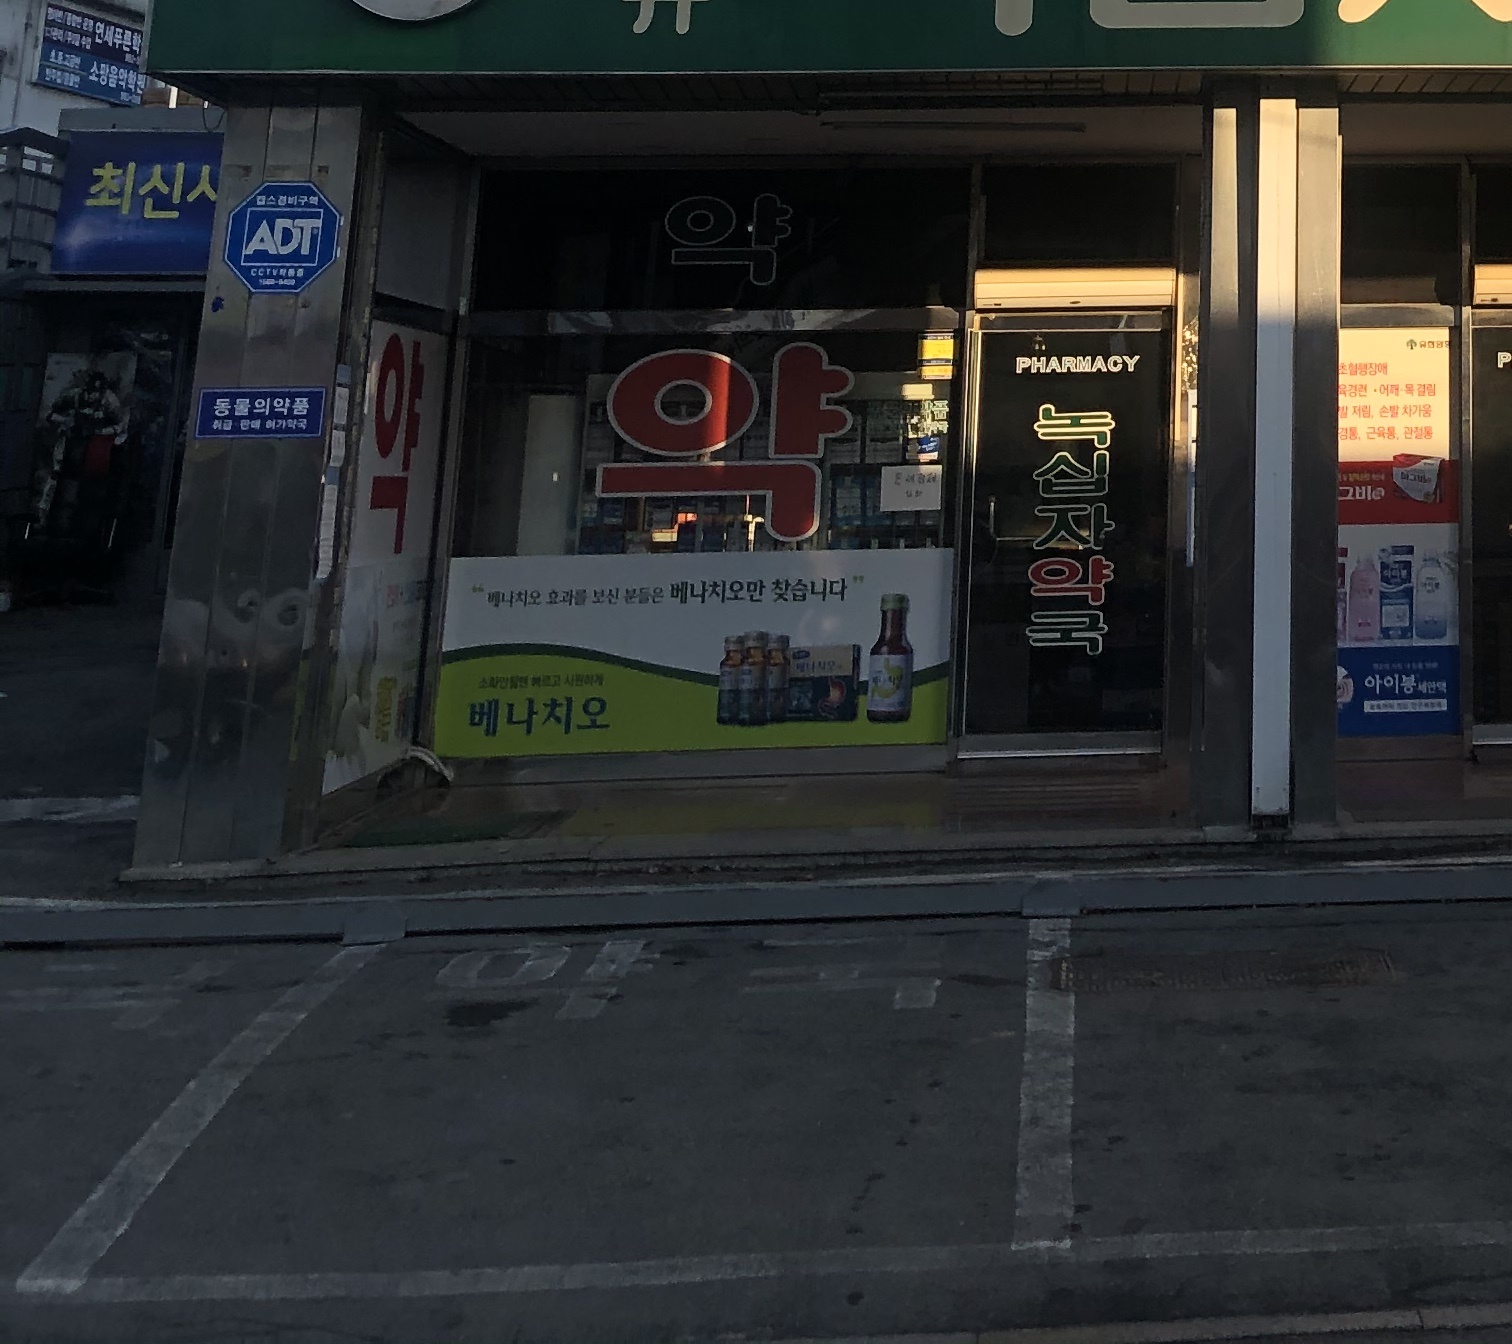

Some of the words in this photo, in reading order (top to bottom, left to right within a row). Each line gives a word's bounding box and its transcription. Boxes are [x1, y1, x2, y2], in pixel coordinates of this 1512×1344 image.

[244, 218, 322, 255] ADT
[664, 193, 794, 286] 약
[1015, 355, 1140, 374] PHARMACY
[213, 397, 310, 417] 동물의약품
[596, 342, 855, 542] 약
[487, 590, 543, 609] 베나치오
[546, 588, 587, 606] 효과를
[670, 580, 765, 605] 베나치오만
[771, 577, 847, 603] 찾습니다
[467, 695, 611, 737] 베나치오
